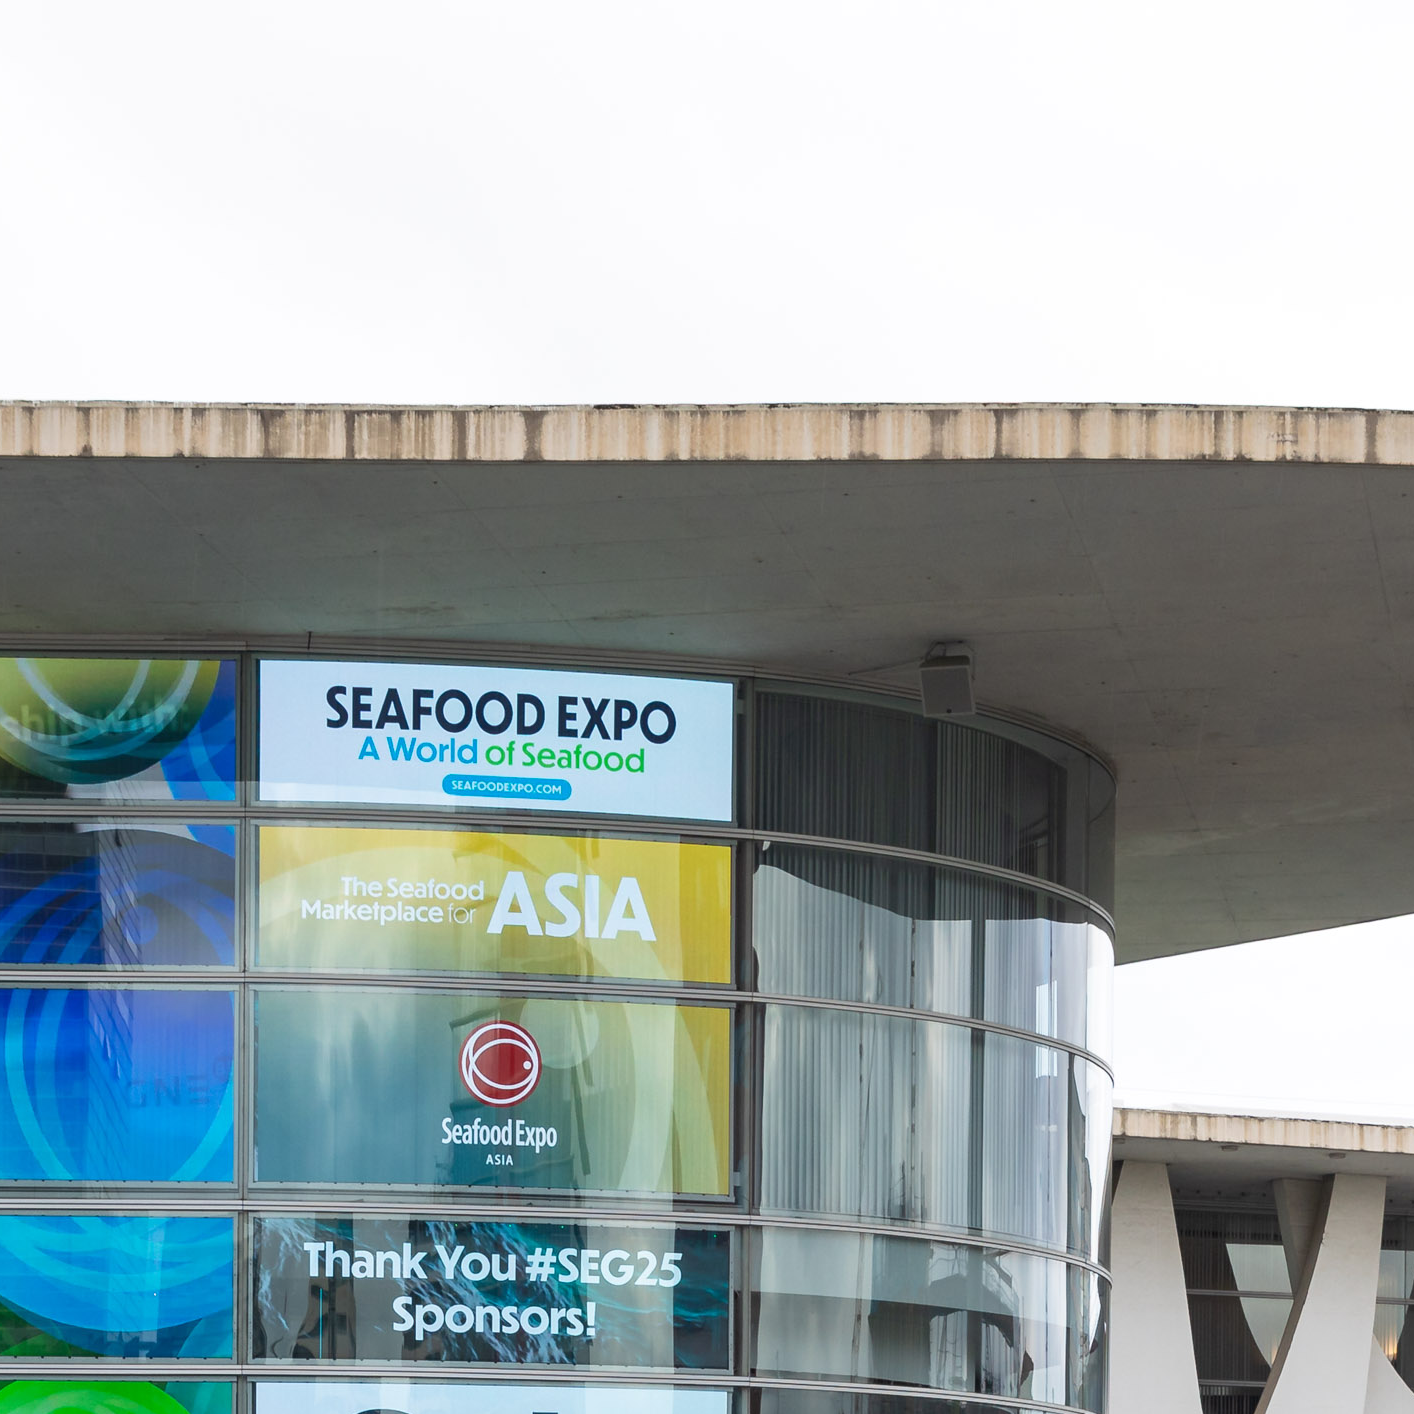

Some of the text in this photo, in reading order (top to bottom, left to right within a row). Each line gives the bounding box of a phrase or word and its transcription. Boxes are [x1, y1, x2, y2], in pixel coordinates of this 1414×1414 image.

[326, 685, 677, 744] SEAFOOD EXPO
[358, 736, 645, 773] A World of Seafood
[451, 780, 562, 796] SEAFOODEXPO.COM
[341, 877, 484, 901] The Seafood
[487, 871, 656, 941] ASIA
[302, 900, 477, 925] Marketplace for
[442, 1117, 557, 1153] Seafood Expo
[486, 1154, 514, 1166] ASIA
[304, 1242, 683, 1287] Thank You #SEG25
[393, 1296, 596, 1341] Sponsors!
